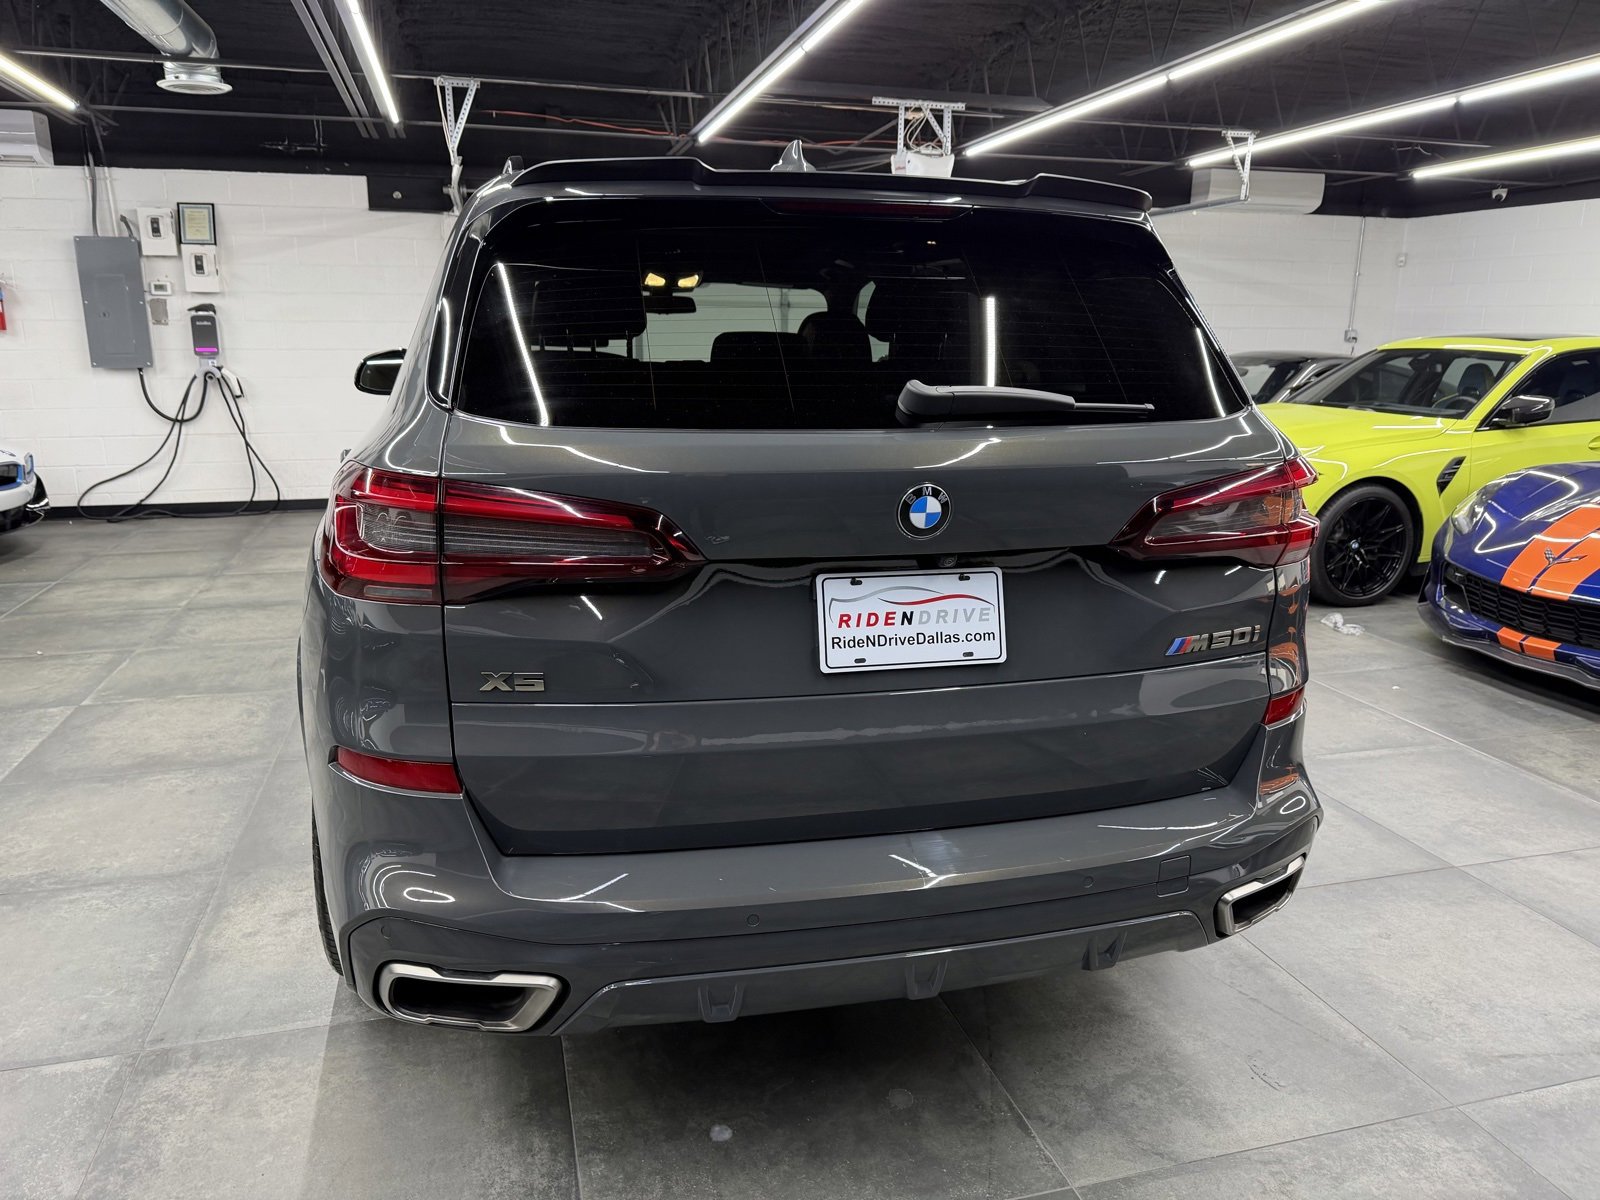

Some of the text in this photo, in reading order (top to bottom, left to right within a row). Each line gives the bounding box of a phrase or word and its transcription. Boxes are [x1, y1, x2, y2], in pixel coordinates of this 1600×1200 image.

[905, 486, 948, 504] BMW
[831, 631, 996, 650] RideNDriveDallas.com
[1184, 624, 1261, 654] M50i
[479, 671, 545, 691] X5
